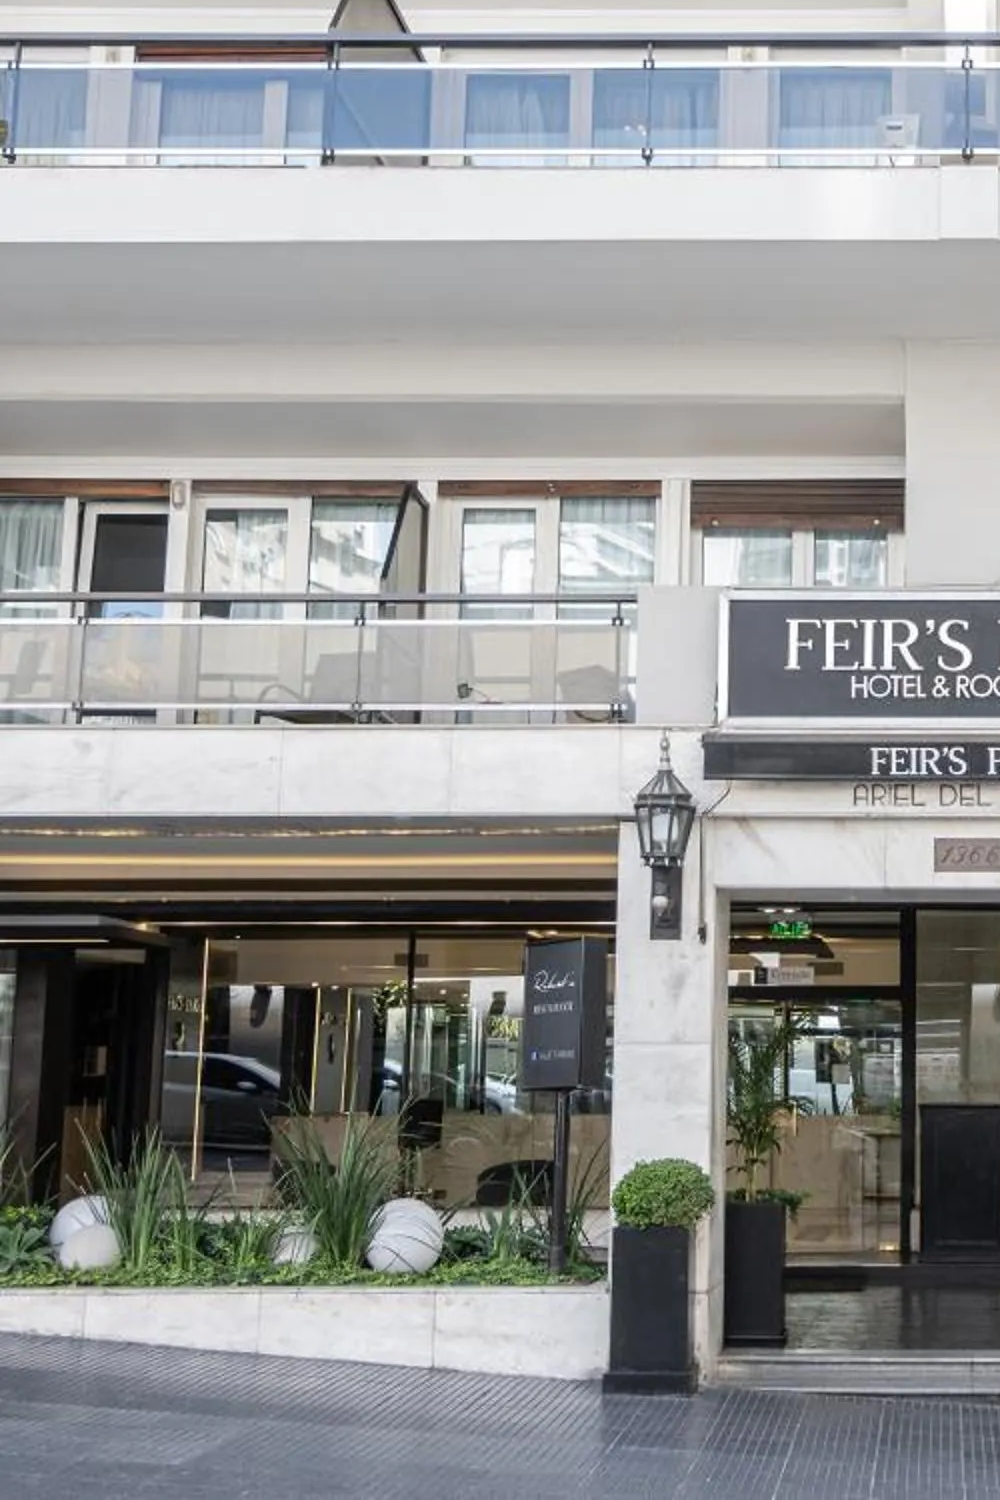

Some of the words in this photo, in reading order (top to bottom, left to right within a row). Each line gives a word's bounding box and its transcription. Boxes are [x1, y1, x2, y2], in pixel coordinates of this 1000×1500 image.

[783, 618, 972, 672] FEIR'S
[850, 674, 927, 699] HOTEL
[932, 674, 950, 698] &
[869, 746, 968, 776] FEIR'S
[852, 783, 927, 807] ARIEL
[939, 783, 993, 807] DEL
